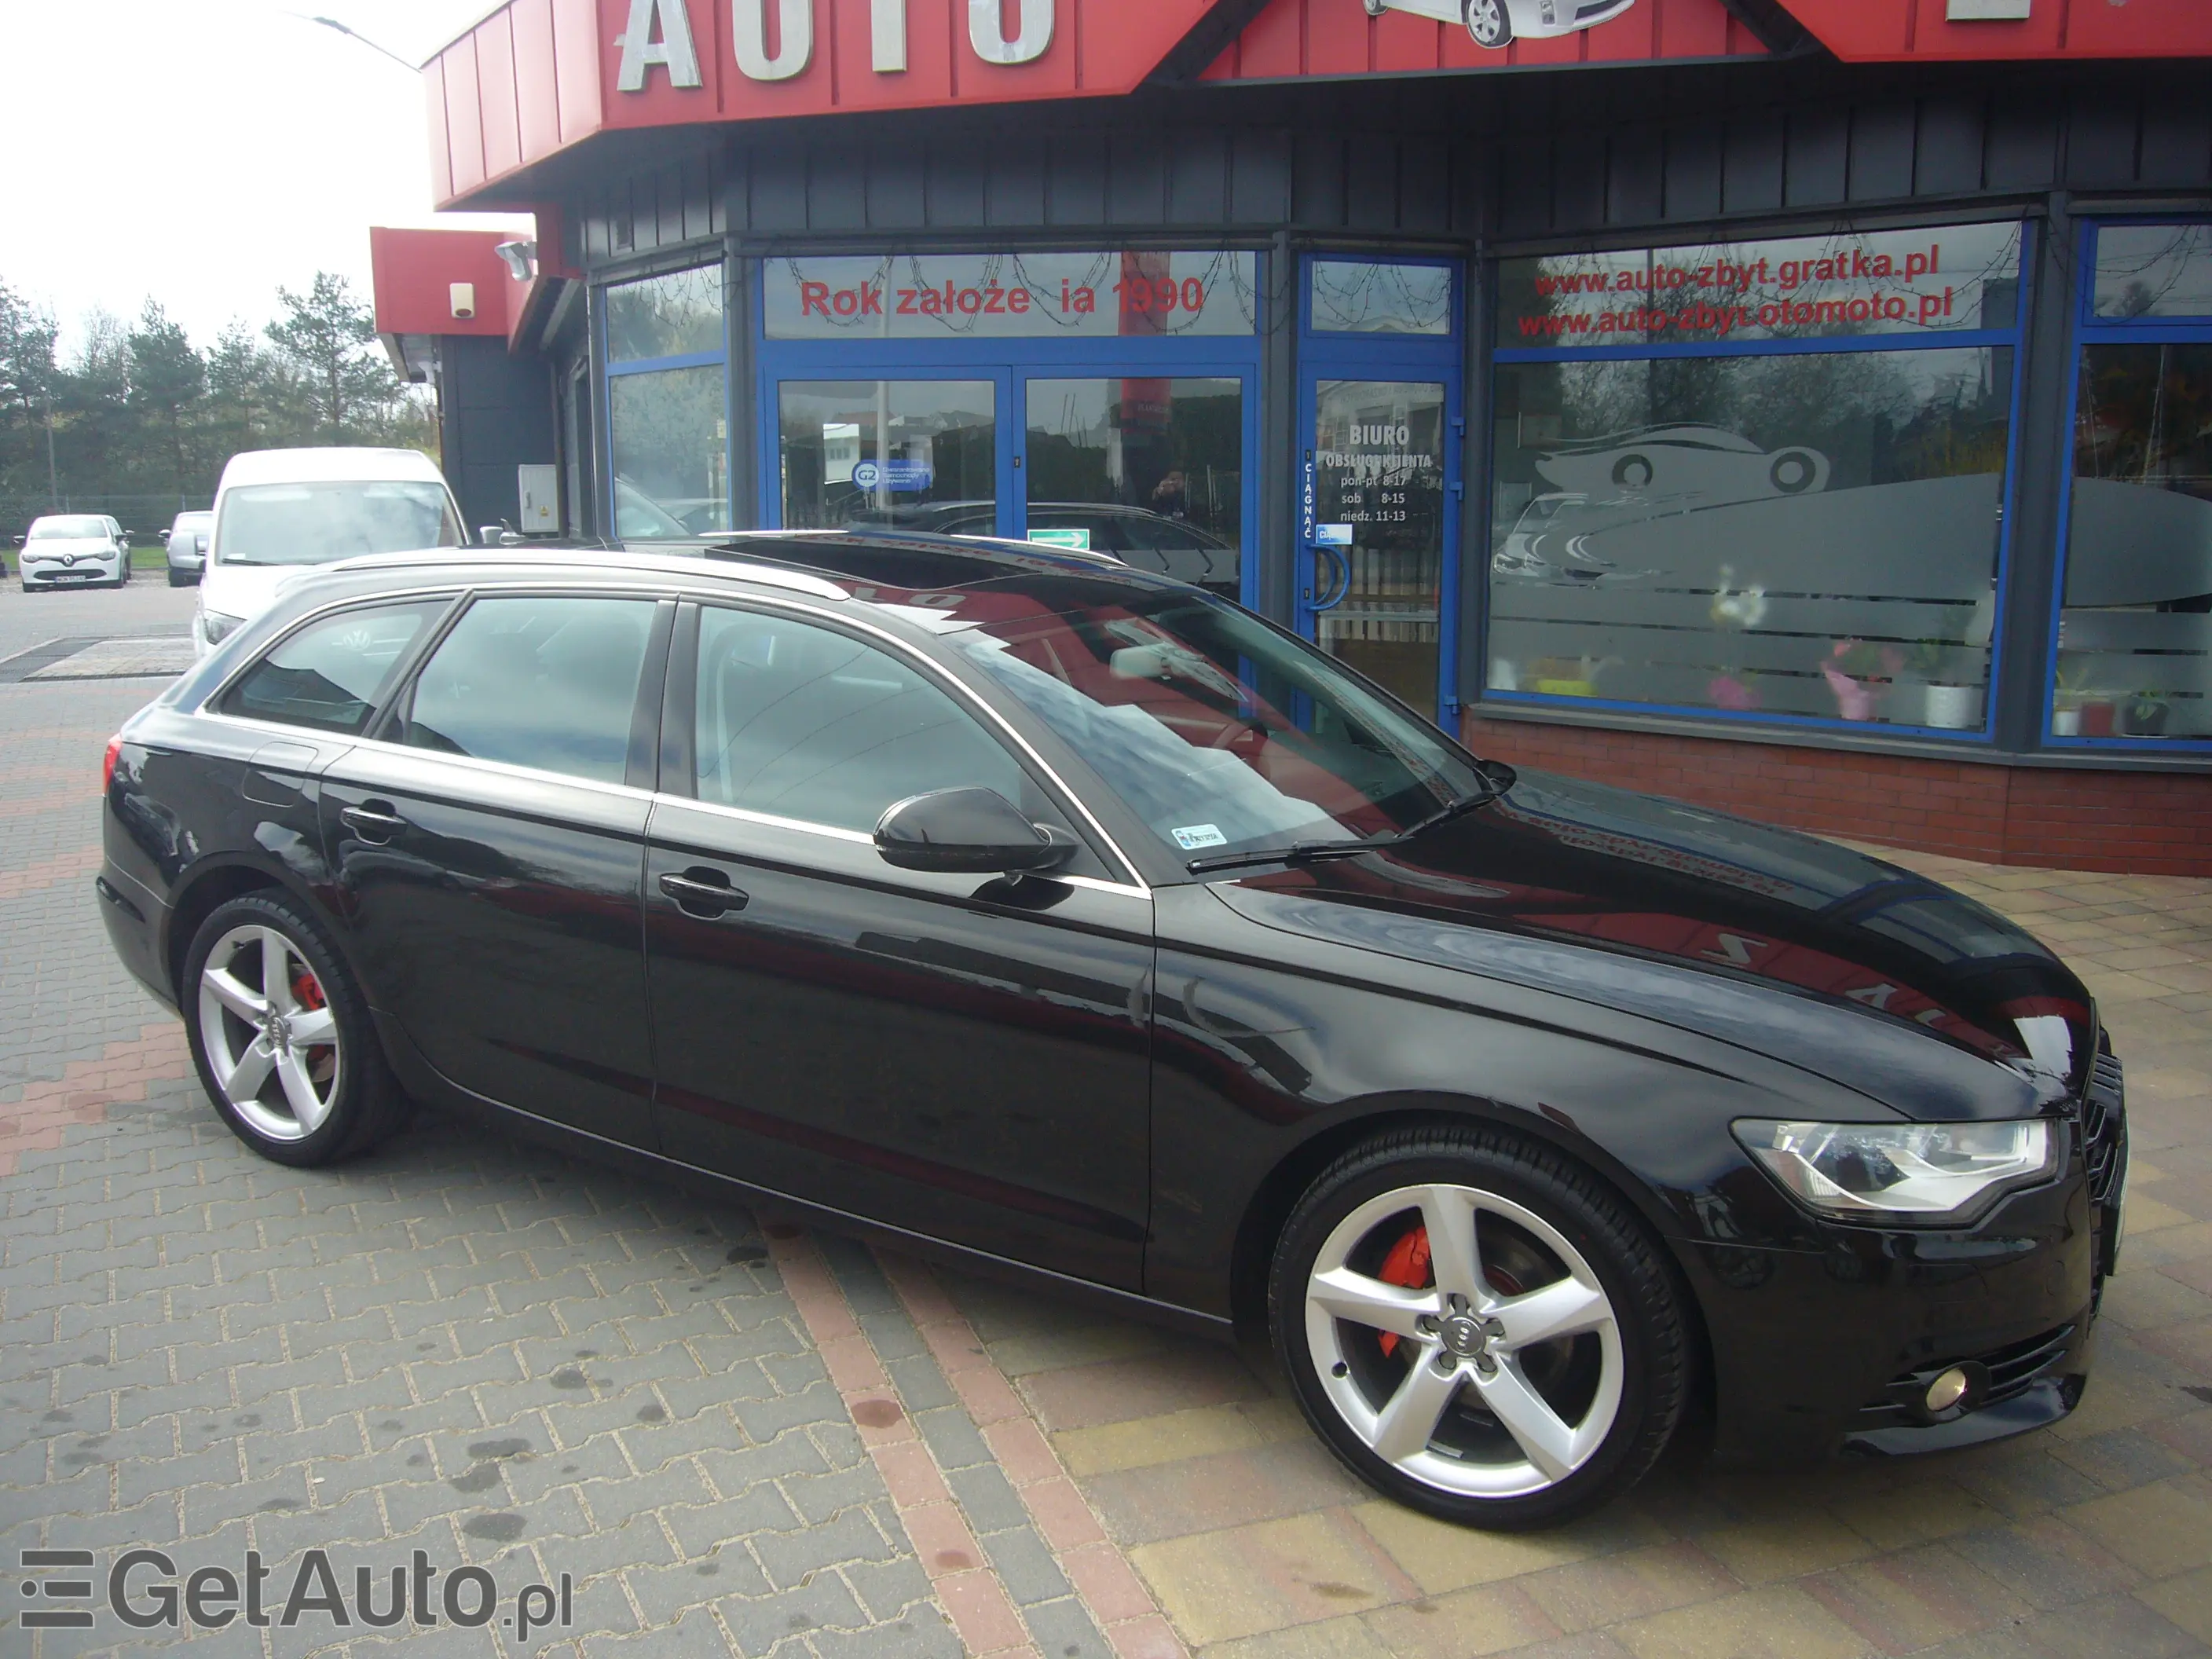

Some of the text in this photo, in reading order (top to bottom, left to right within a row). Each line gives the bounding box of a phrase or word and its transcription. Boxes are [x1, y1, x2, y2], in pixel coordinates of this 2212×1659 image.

[1534, 244, 1940, 295] www.auto-zbyt.gratka.pl
[801, 280, 883, 316] Rok
[1112, 277, 1203, 313] 1990
[1518, 287, 1954, 336] www.auto-zbyt.otomoto.pl
[1350, 425, 1410, 445] BIURO
[1382, 475, 1407, 487] 8-17
[1381, 493, 1405, 504] 8-15
[1340, 511, 1406, 522] niedz. 11-13
